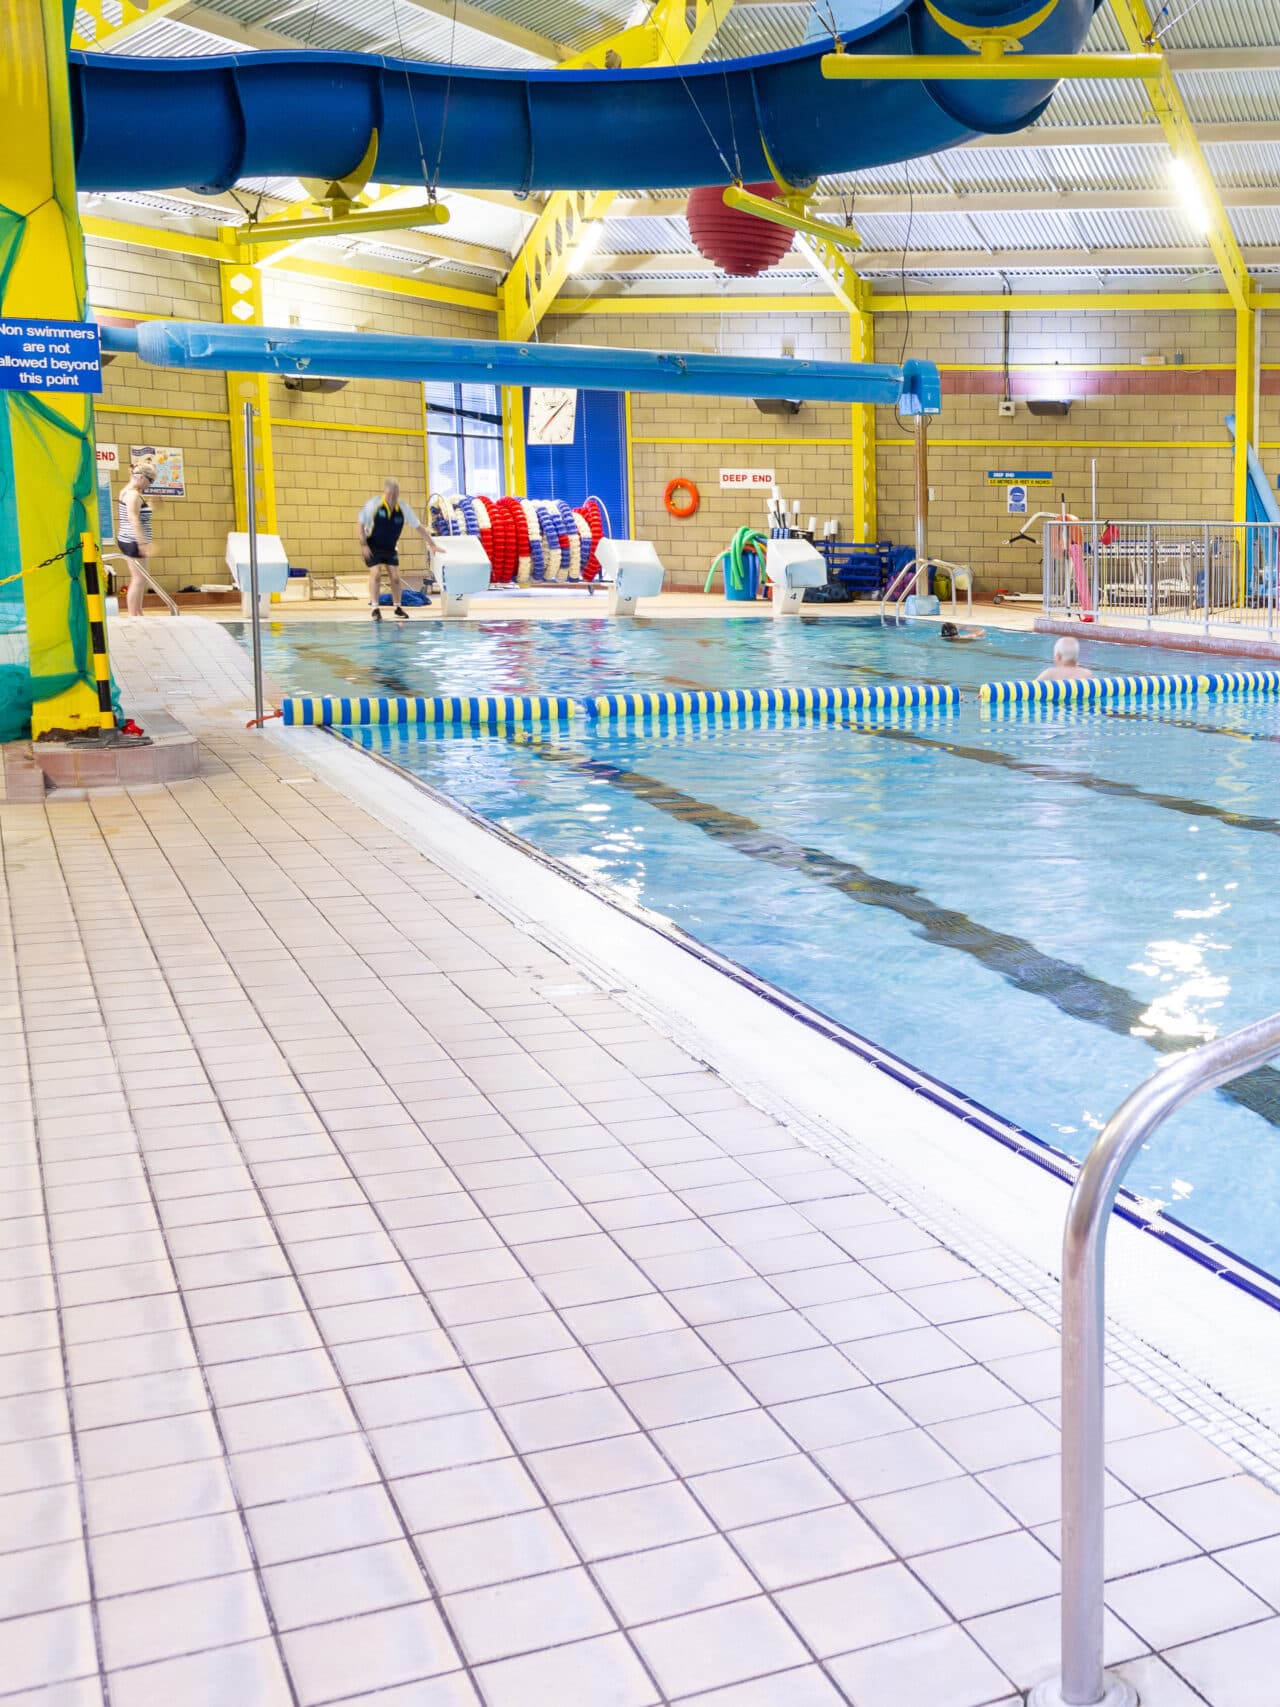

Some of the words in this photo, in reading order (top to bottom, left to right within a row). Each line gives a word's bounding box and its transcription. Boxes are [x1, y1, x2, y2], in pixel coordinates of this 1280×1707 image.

[0, 323, 23, 336] Non
[26, 325, 96, 340] swimmers
[22, 342, 46, 353] are
[48, 342, 72, 355] not
[0, 355, 48, 369] allowed
[50, 357, 100, 373] beyond
[19, 372, 43, 385] this
[45, 373, 80, 388] point
[96, 450, 117, 462] END
[722, 474, 748, 483] DEEP
[752, 474, 773, 483] END
[456, 593, 464, 601] 2
